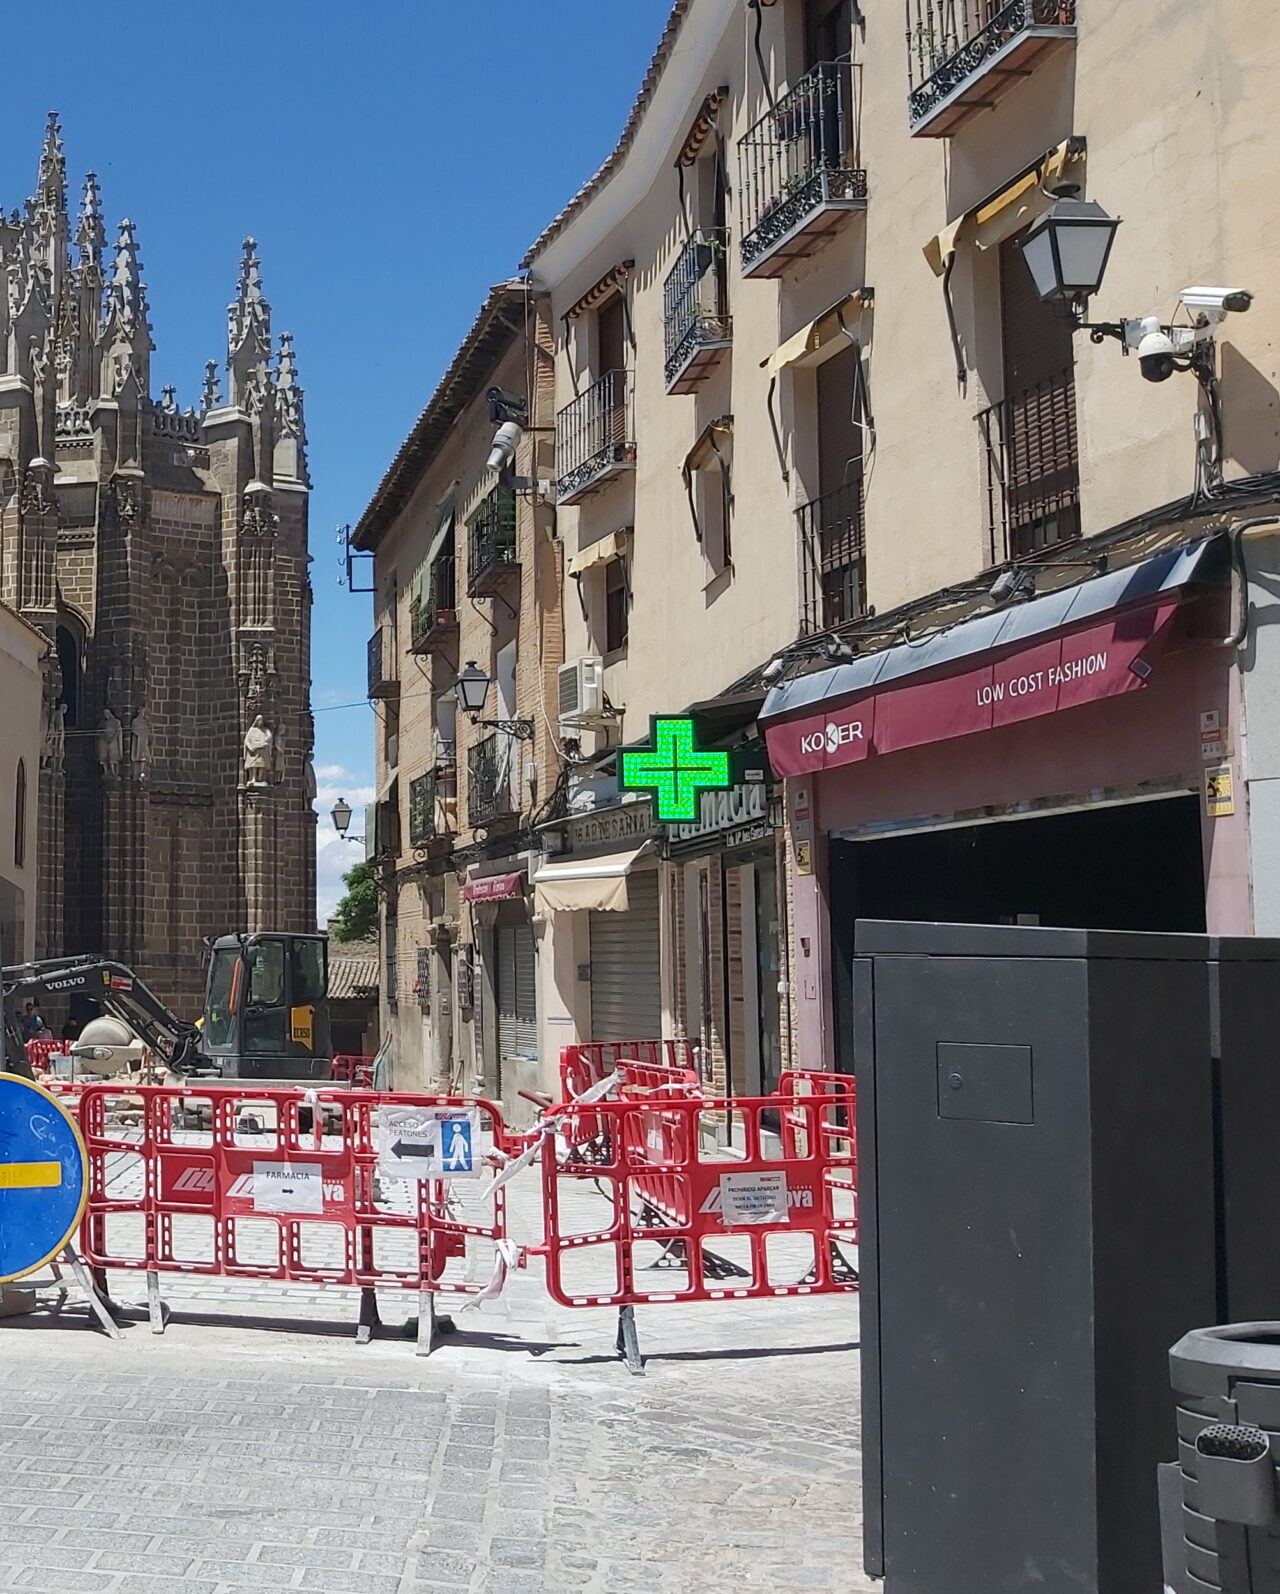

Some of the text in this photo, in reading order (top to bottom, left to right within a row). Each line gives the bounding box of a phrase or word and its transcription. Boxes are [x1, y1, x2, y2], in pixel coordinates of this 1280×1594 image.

[977, 652, 1107, 706] LOW COST FASHION
[801, 720, 863, 754] KOKER
[45, 976, 85, 990] VOLVO
[389, 1120, 419, 1129] ACCESO
[389, 1129, 427, 1138] PEATONES
[266, 1171, 310, 1180] FARMACIA
